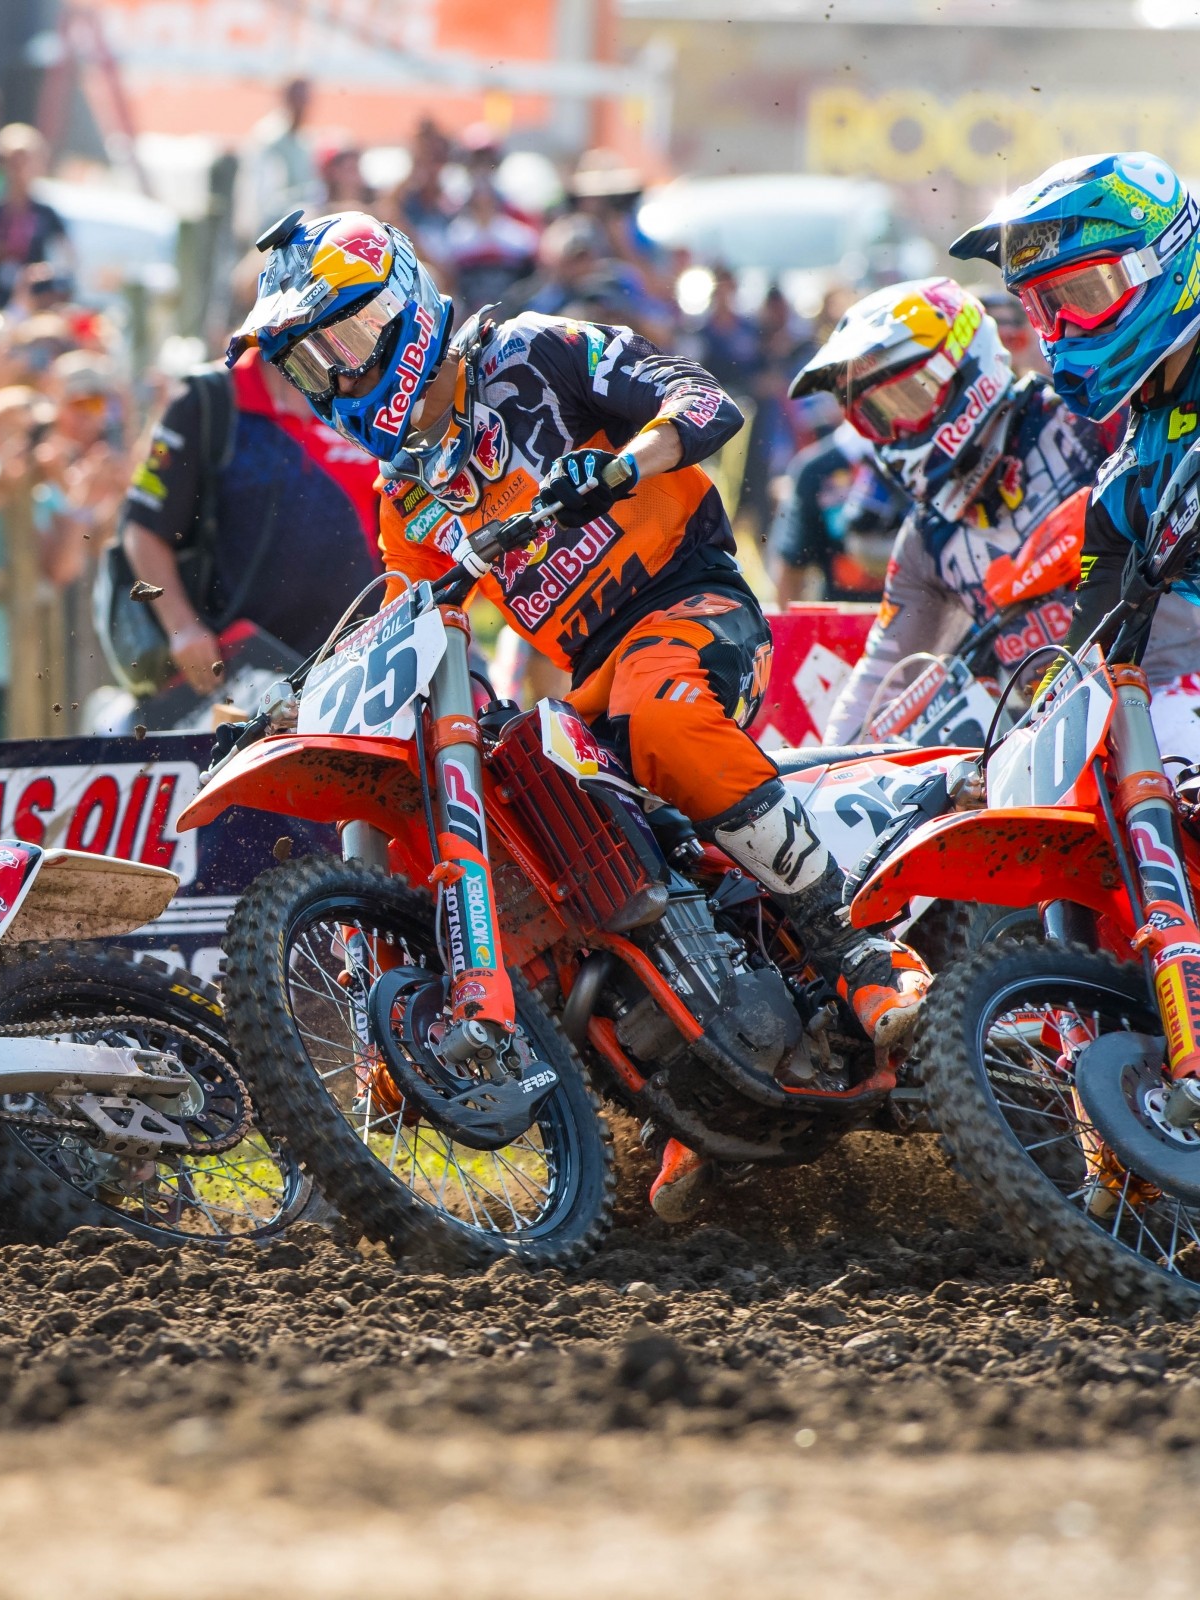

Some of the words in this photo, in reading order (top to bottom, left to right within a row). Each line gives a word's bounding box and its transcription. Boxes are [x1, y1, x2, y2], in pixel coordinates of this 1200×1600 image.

[300, 283, 325, 308] Airoh
[510, 564, 567, 629] Red
[548, 514, 617, 586] Bull
[381, 616, 404, 642] OIL
[319, 621, 418, 735] 25
[65, 775, 179, 872] OIL
[464, 873, 489, 944] MOTOREX
